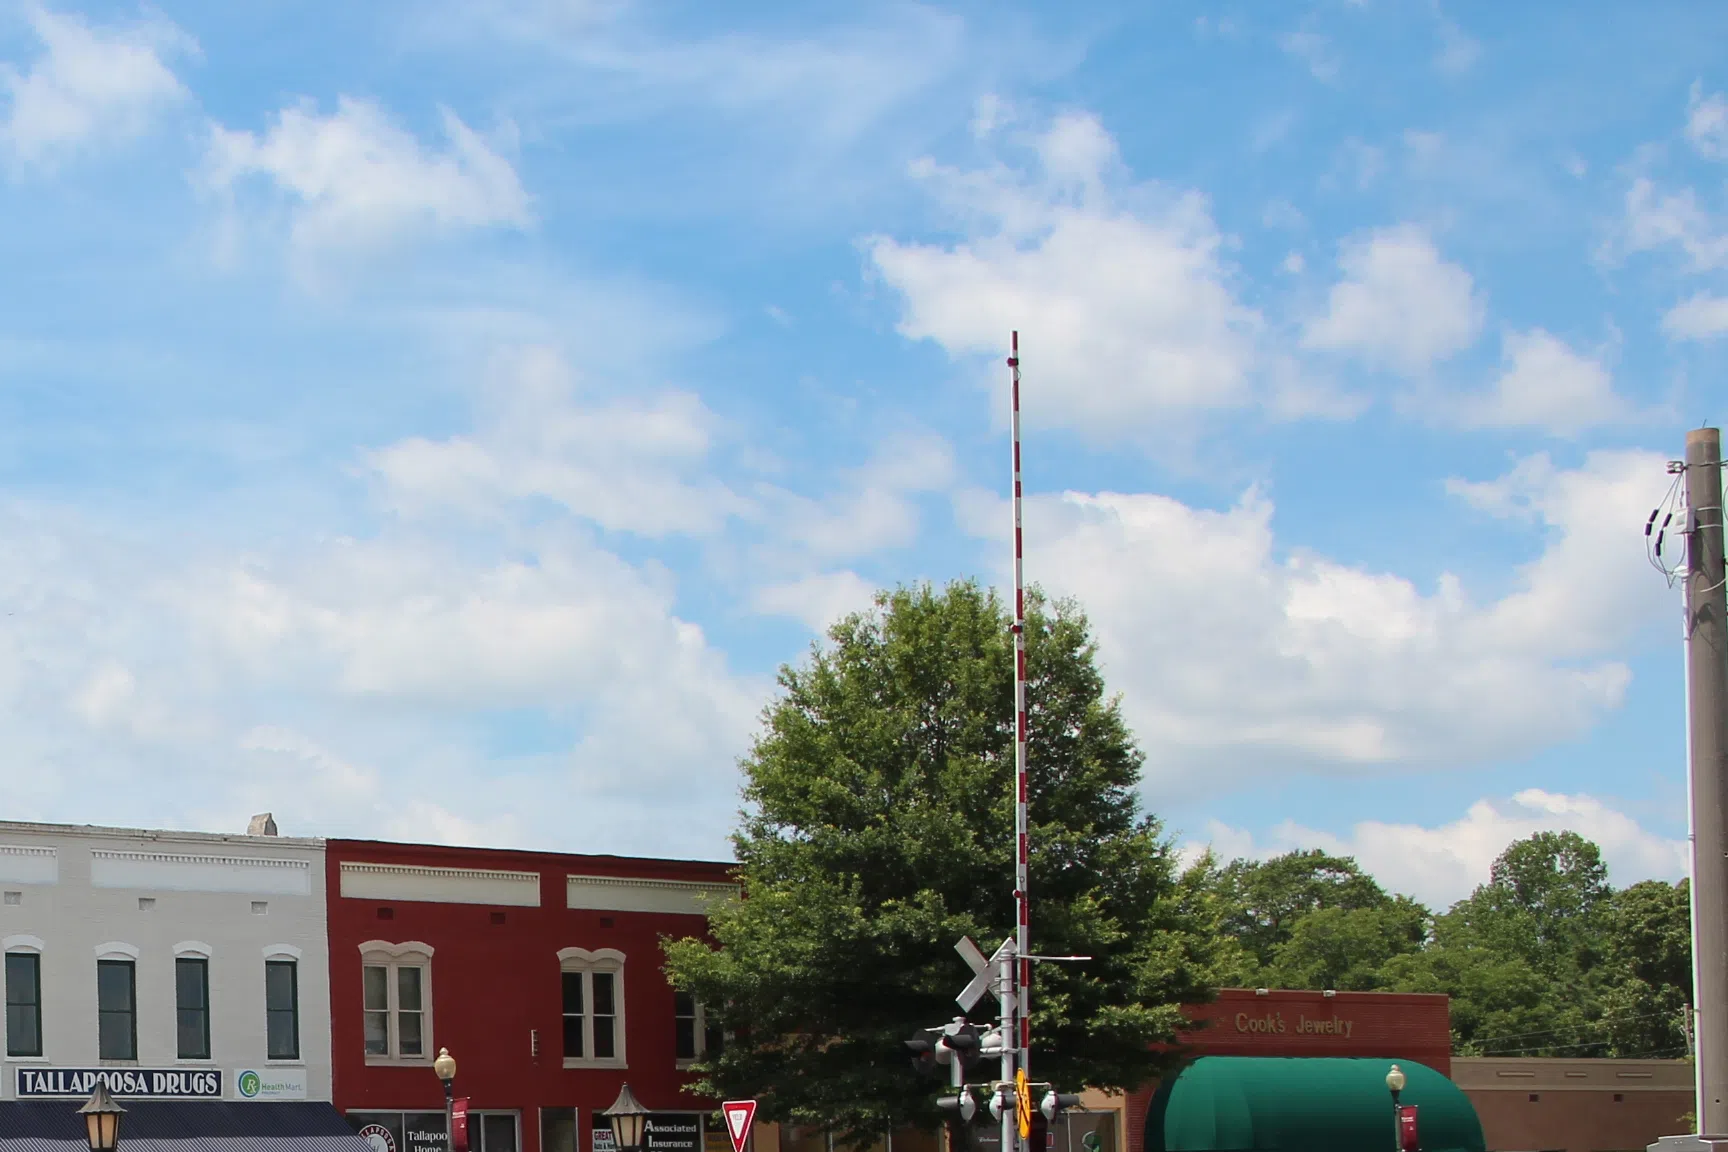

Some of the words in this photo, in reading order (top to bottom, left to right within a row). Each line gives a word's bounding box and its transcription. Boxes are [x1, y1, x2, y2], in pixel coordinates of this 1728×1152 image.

[1235, 1012, 1286, 1033] Cook's
[1296, 1014, 1352, 1039] Jewelry
[23, 1071, 150, 1094] TALLAPOOSA
[153, 1072, 218, 1094] DRUGS
[261, 1083, 284, 1091] Health
[644, 1120, 697, 1133] Associated
[594, 1131, 612, 1140] GREAT
[648, 1135, 693, 1148] Insurance
